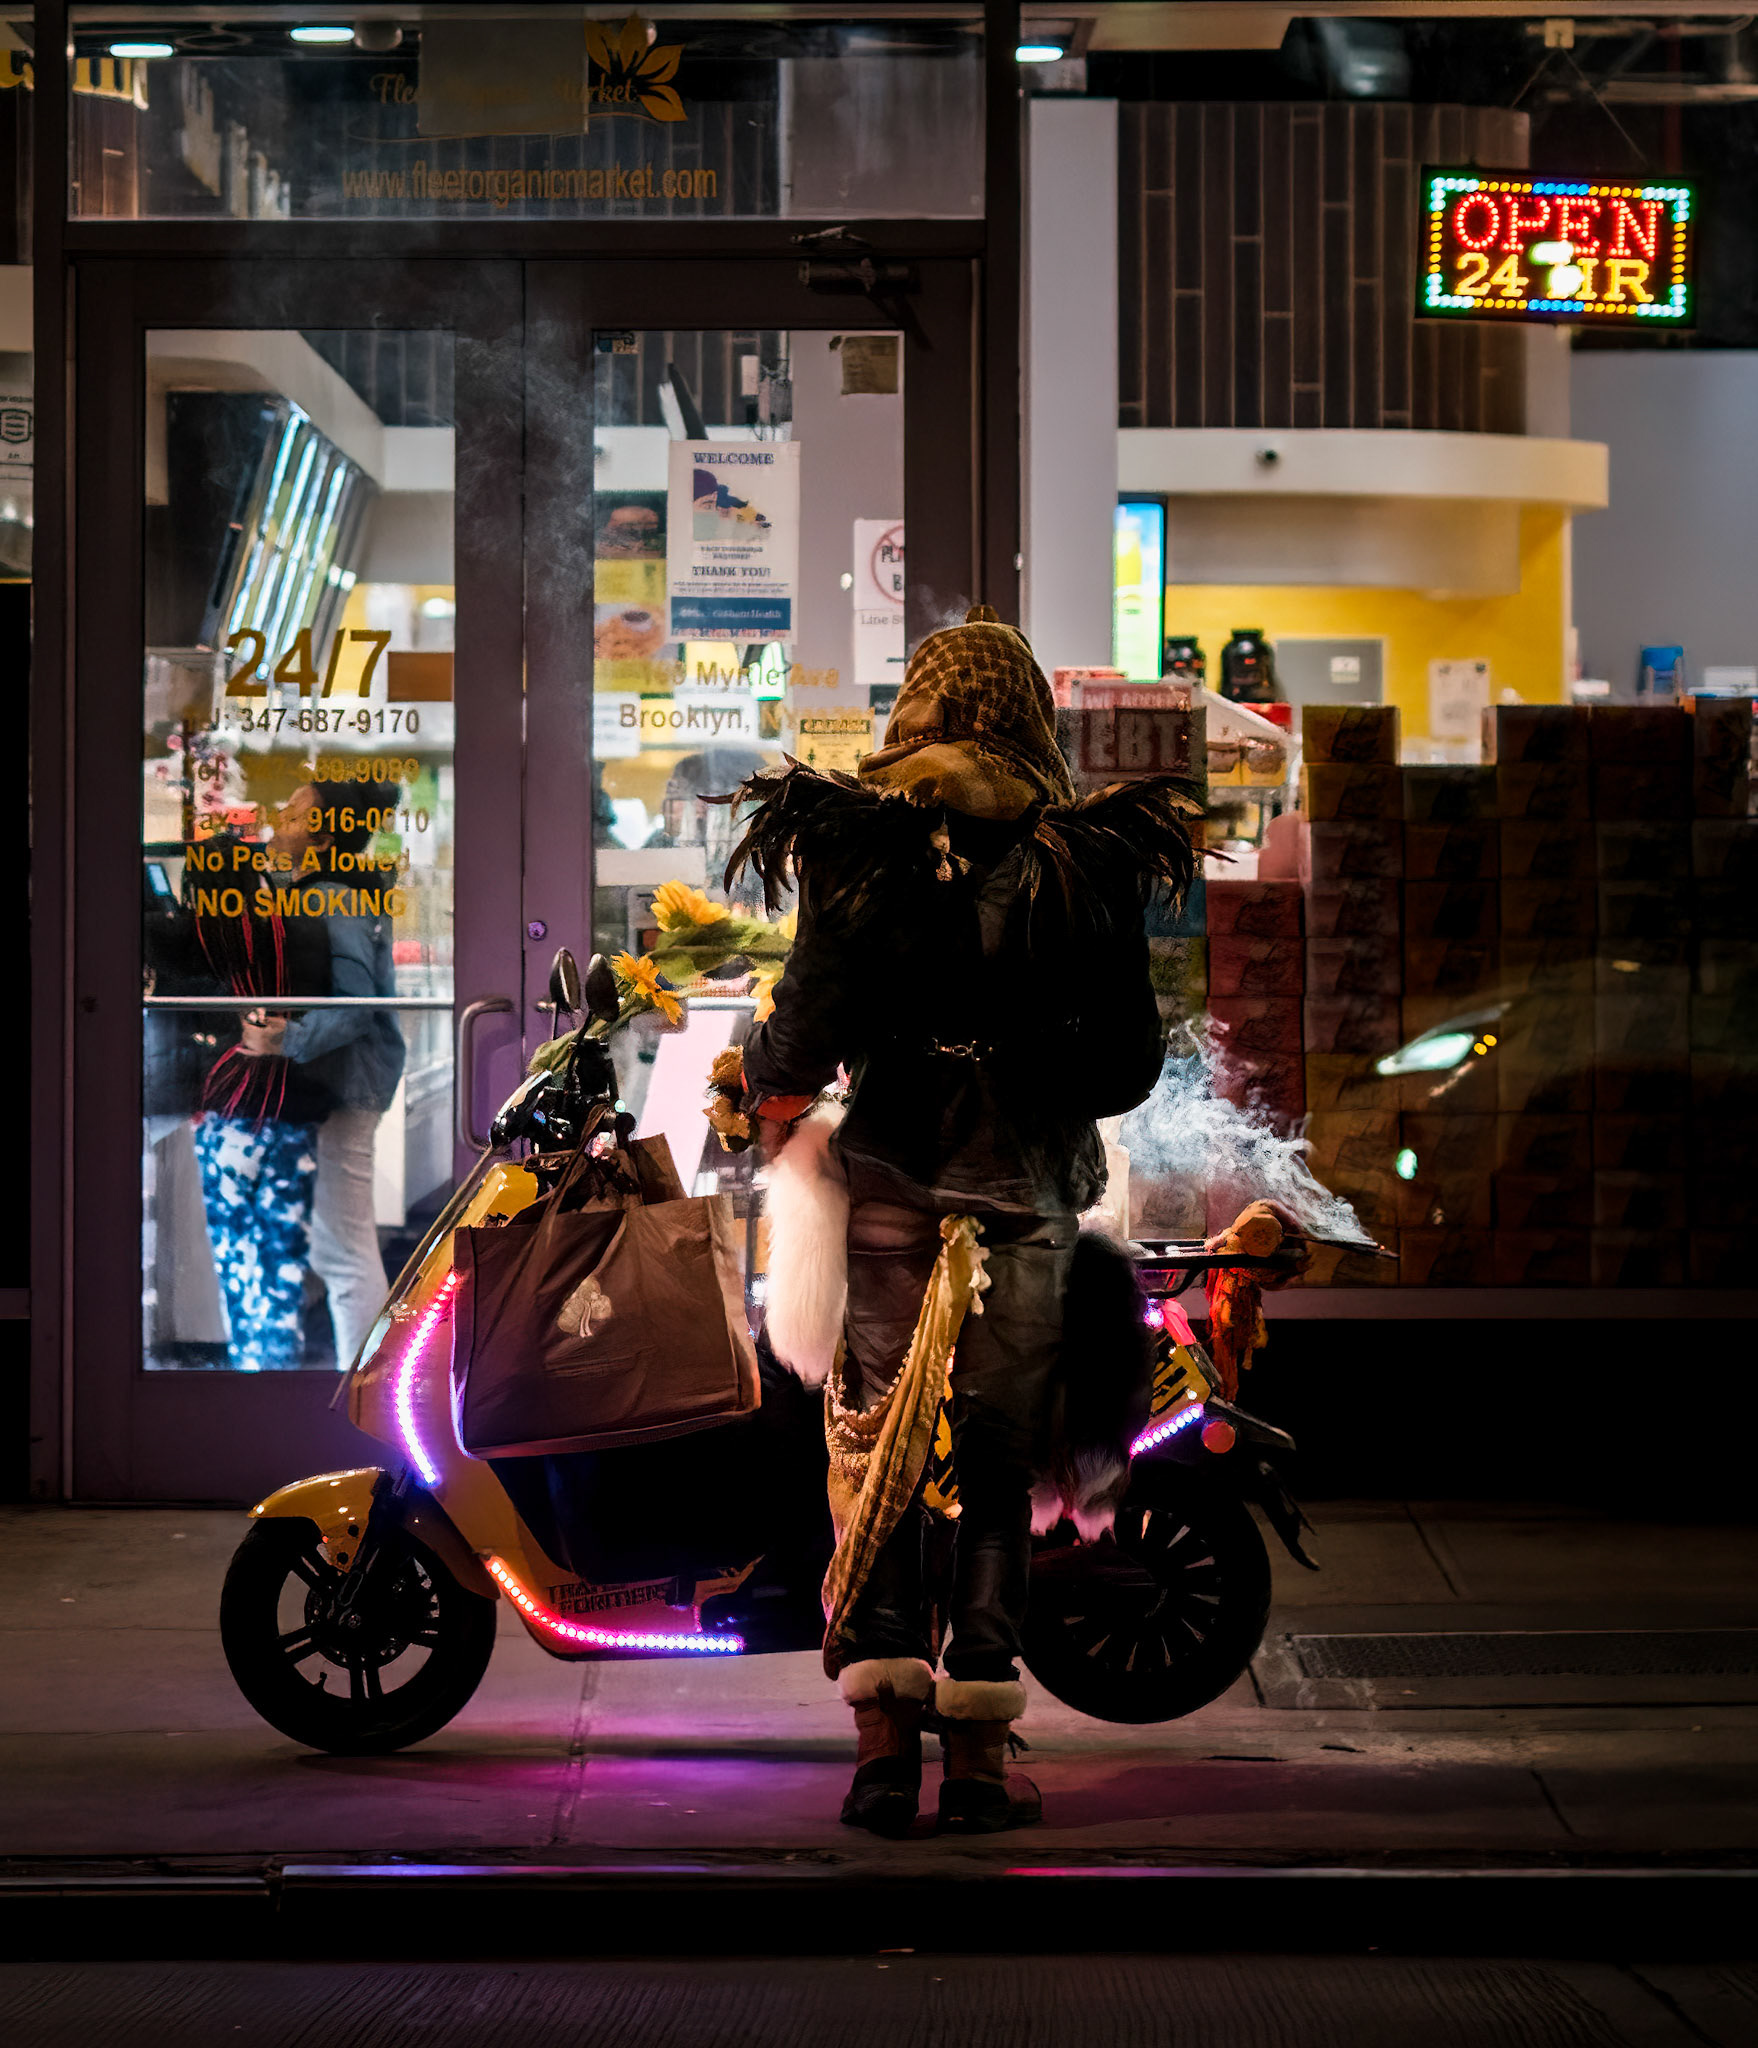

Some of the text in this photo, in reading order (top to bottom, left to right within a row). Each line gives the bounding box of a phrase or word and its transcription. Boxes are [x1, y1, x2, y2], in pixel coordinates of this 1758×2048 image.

[341, 161, 718, 209] www.fleetorganicmarket.com
[1452, 191, 1665, 261] OPEN
[1455, 251, 1530, 298] 24
[693, 452, 775, 466] WELCOME
[692, 566, 738, 578] THANK
[225, 627, 392, 699] 24/7
[240, 708, 420, 734] 347-687-9170
[619, 703, 751, 737] Brooklyn,
[1088, 710, 1182, 770] EBT
[186, 845, 411, 874] No Pets Alowed
[196, 887, 407, 919] NO SMOKING
